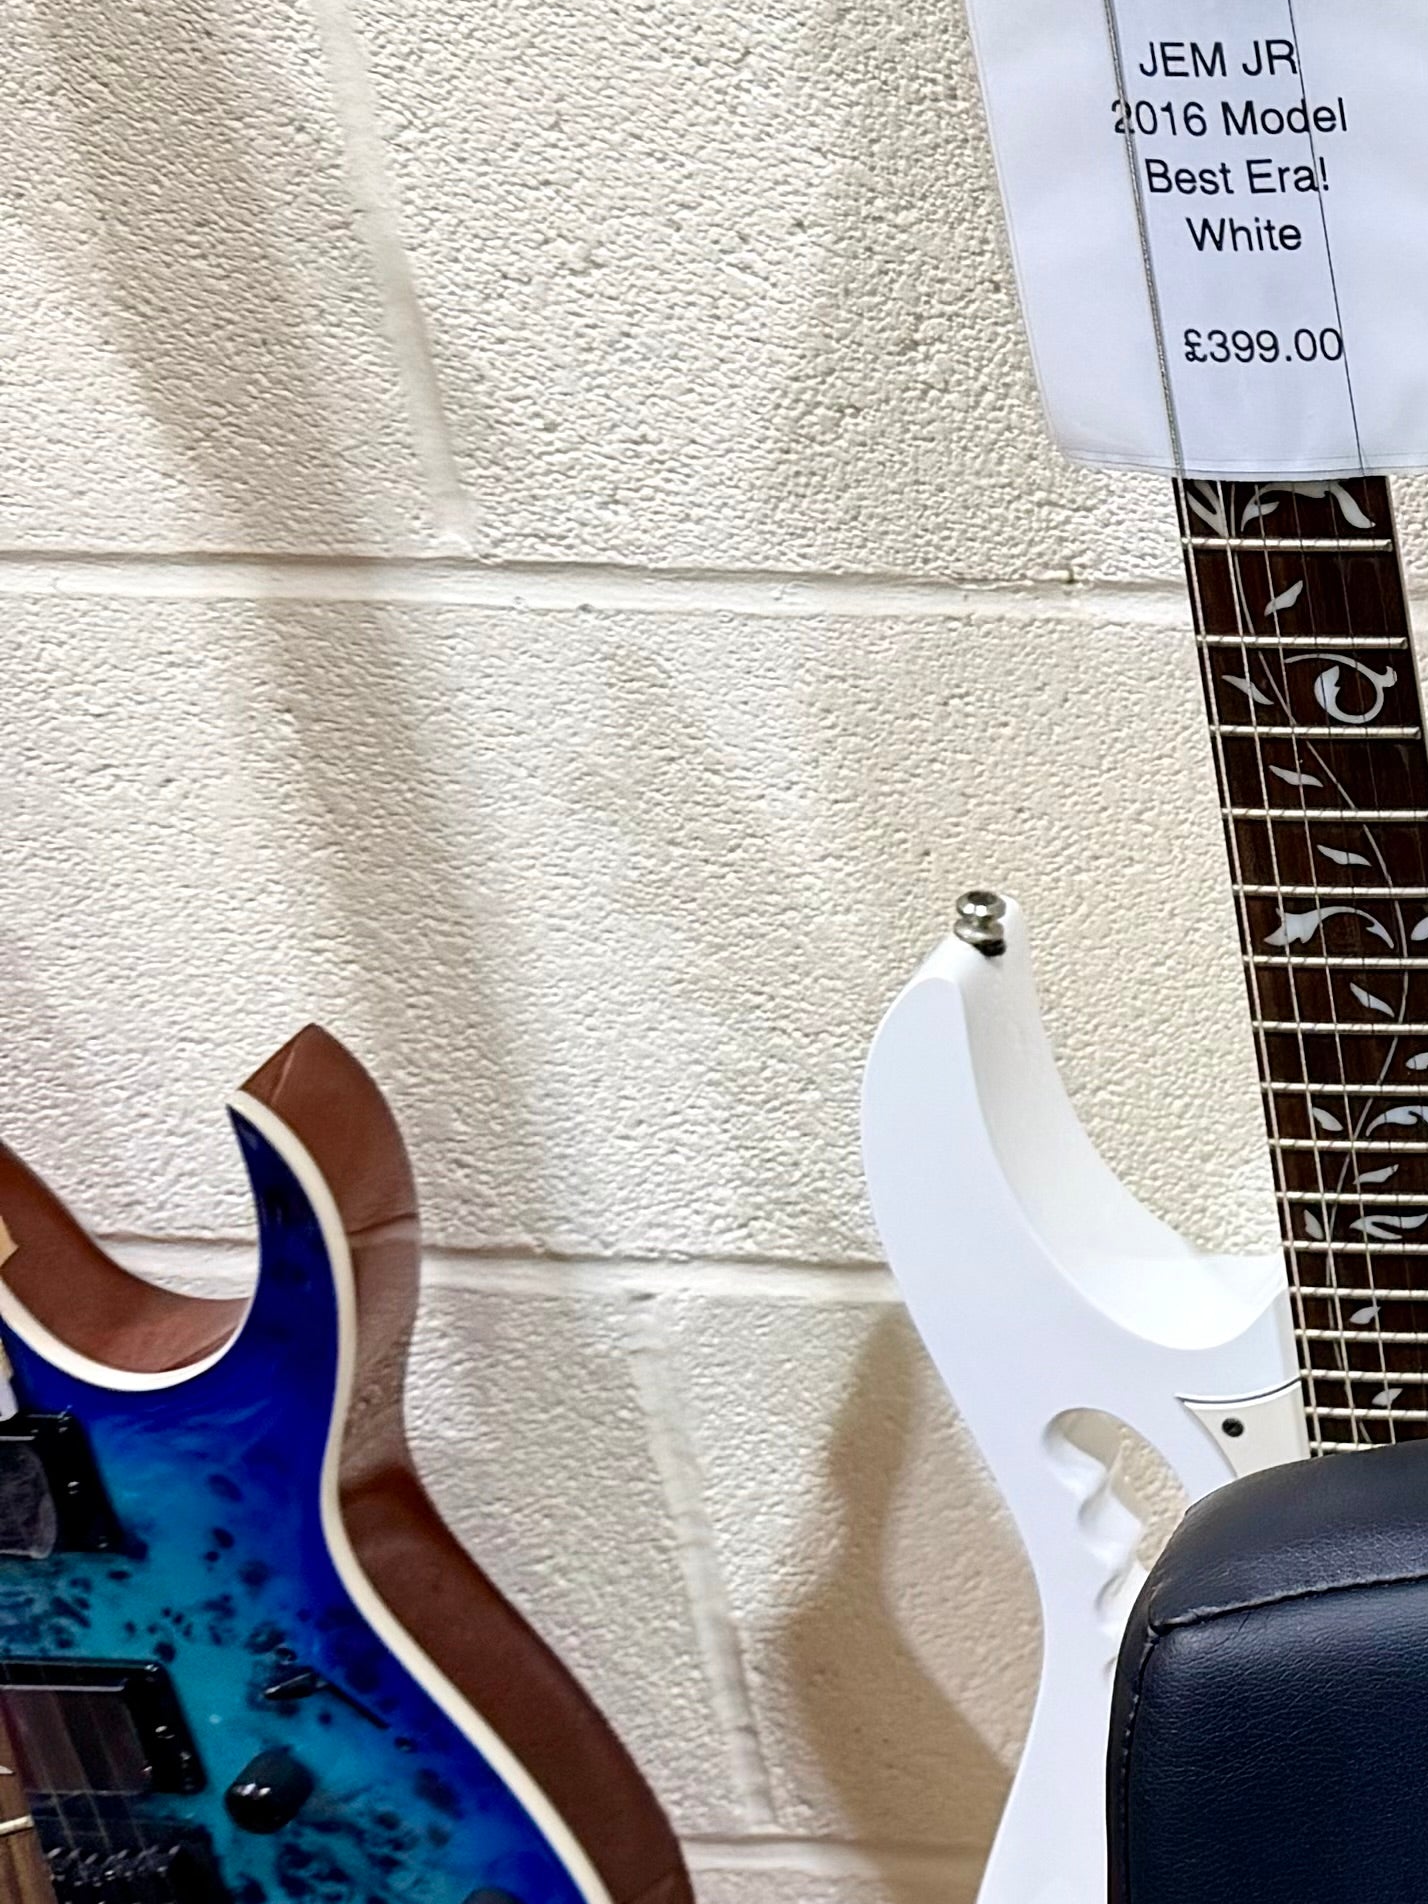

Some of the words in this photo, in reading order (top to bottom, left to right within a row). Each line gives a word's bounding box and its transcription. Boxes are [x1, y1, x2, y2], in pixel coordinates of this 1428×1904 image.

[1139, 40, 1228, 78] JEM
[1241, 38, 1298, 77] JR
[1111, 98, 1208, 137] 2016
[1221, 96, 1349, 137] Model
[1144, 157, 1235, 195] Best
[1246, 156, 1331, 195] Era!
[1185, 216, 1302, 253] White
[1184, 328, 1344, 363] £399.00
